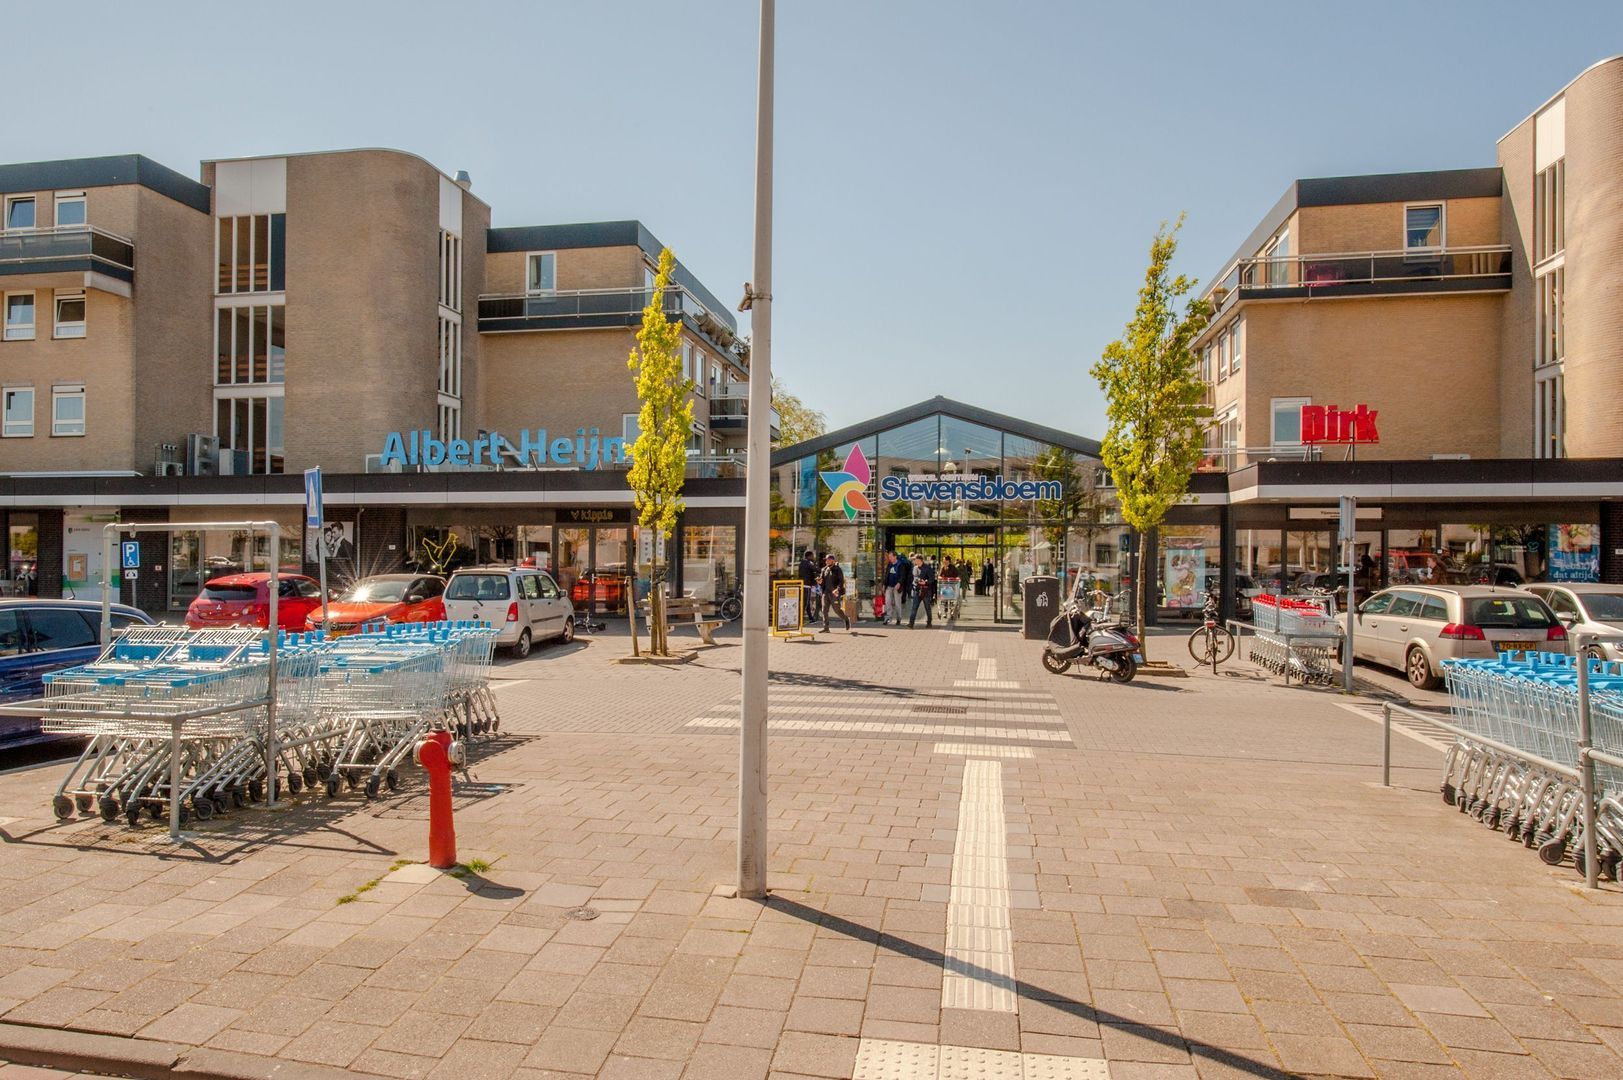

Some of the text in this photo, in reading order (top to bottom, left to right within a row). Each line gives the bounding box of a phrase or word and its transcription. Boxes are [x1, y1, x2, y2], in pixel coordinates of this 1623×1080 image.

[1300, 404, 1379, 442] Dirk
[380, 427, 625, 471] Albert Heijn
[881, 475, 1062, 501] Stevensbloem
[126, 544, 136, 558] P
